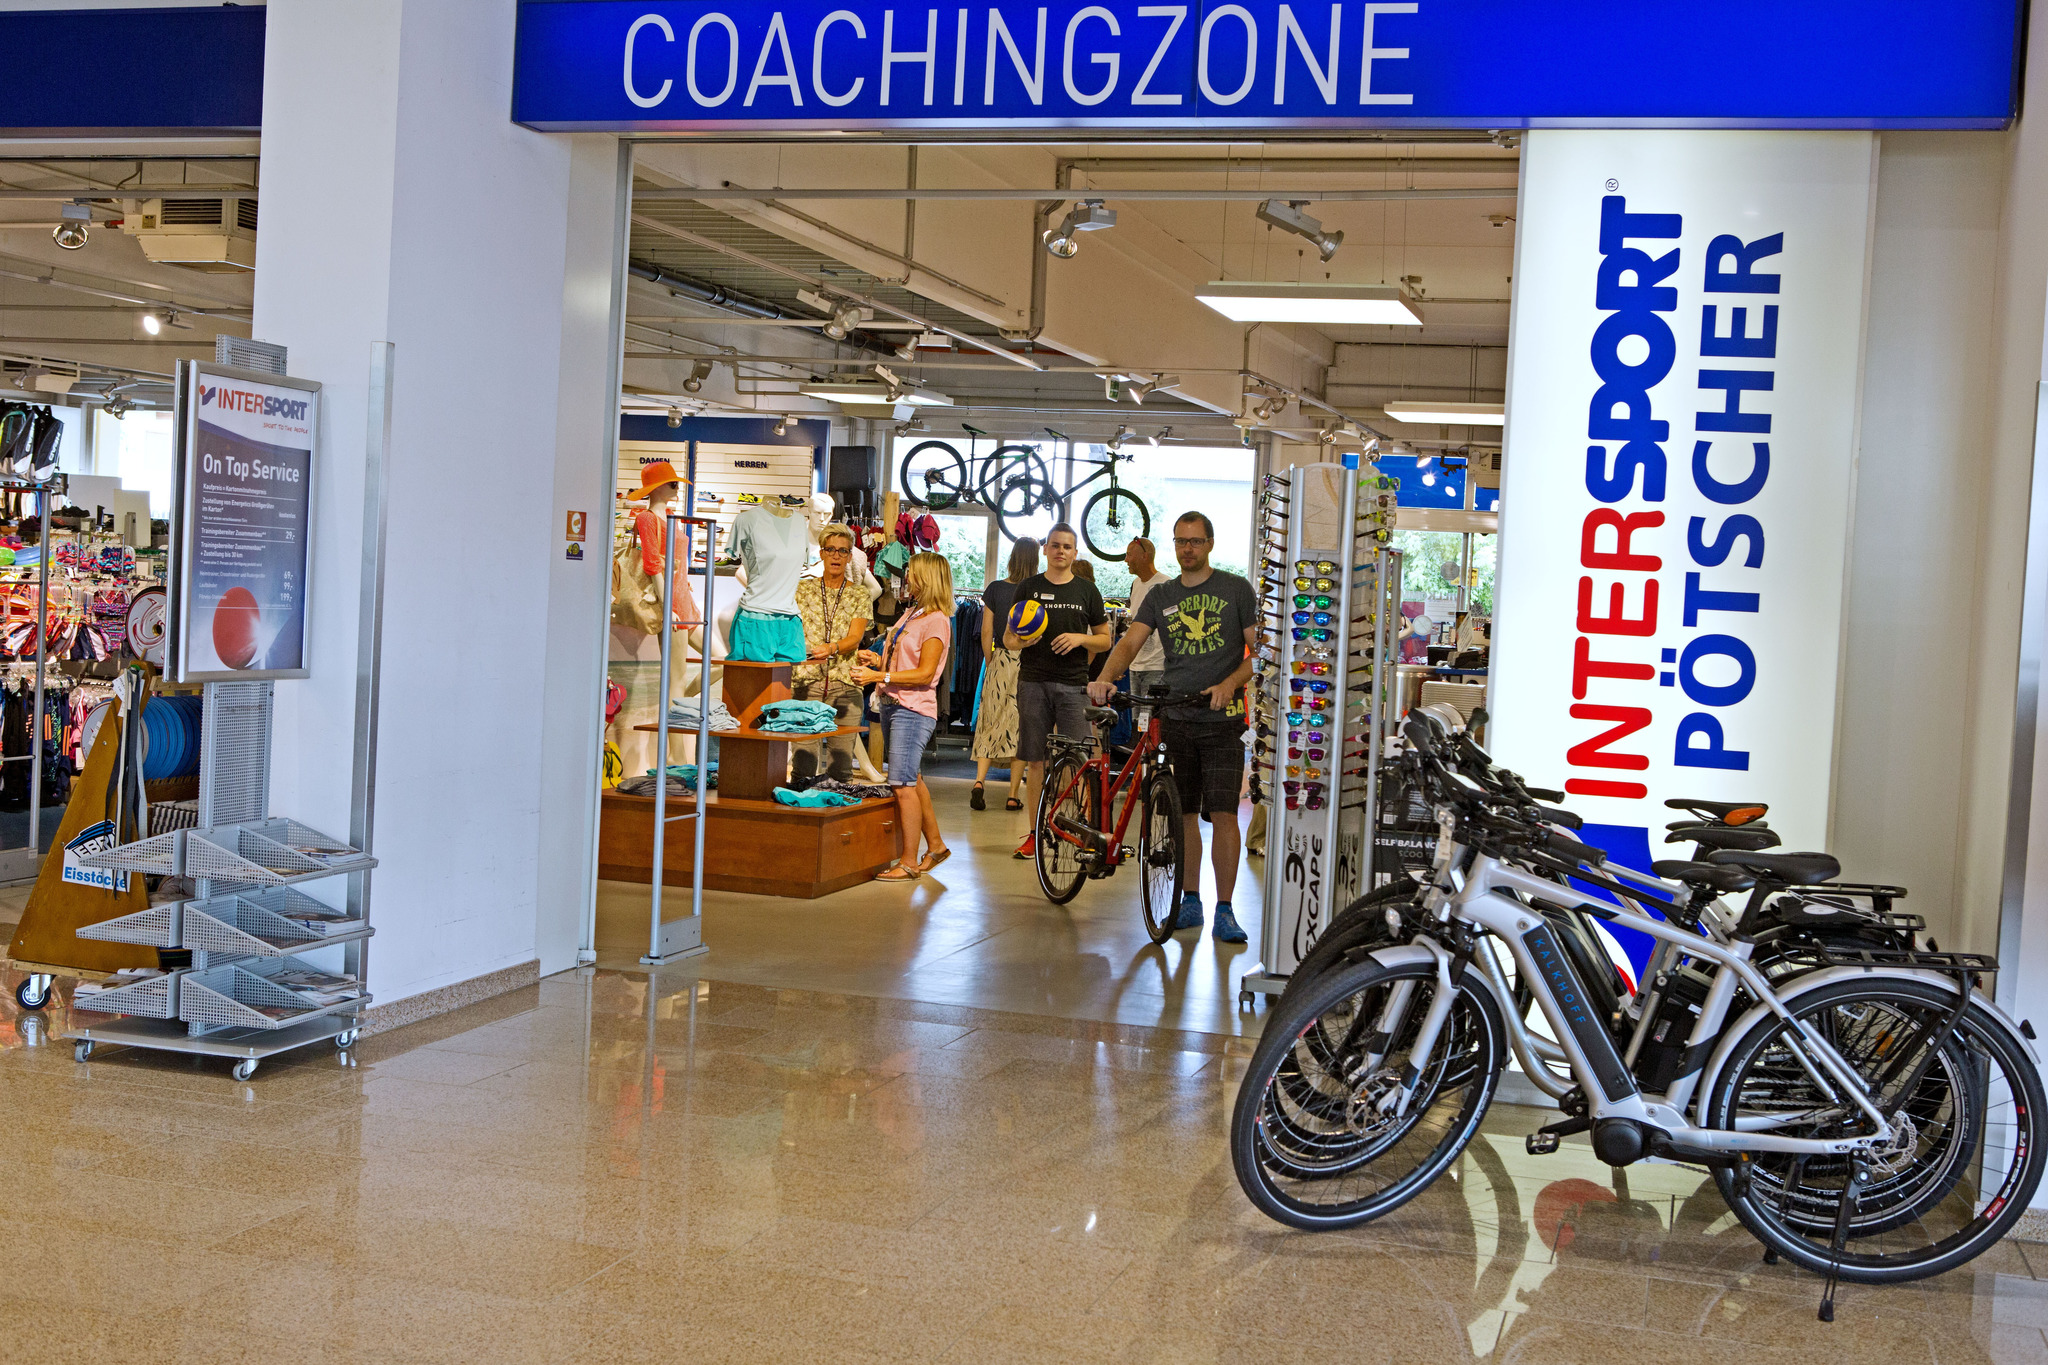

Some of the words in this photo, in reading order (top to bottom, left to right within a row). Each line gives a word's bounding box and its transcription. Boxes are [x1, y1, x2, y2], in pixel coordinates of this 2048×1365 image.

[622, 2, 1415, 108] COACHINGZONE
[217, 386, 308, 421] INTERSPORT
[203, 453, 222, 475] On
[225, 455, 249, 482] Top
[251, 458, 300, 483] Service
[639, 456, 671, 465] DAMEN
[734, 460, 769, 469] HERREN
[1564, 195, 1683, 800] INTERSPORT
[1658, 231, 1785, 772] PÖTSCHER
[1172, 632, 1225, 656] EAGLES
[1374, 838, 1396, 847] SELF
[1397, 839, 1436, 849] BALANC
[1399, 850, 1434, 859] SCOOE
[1534, 938, 1586, 1022] KALKHOFF
